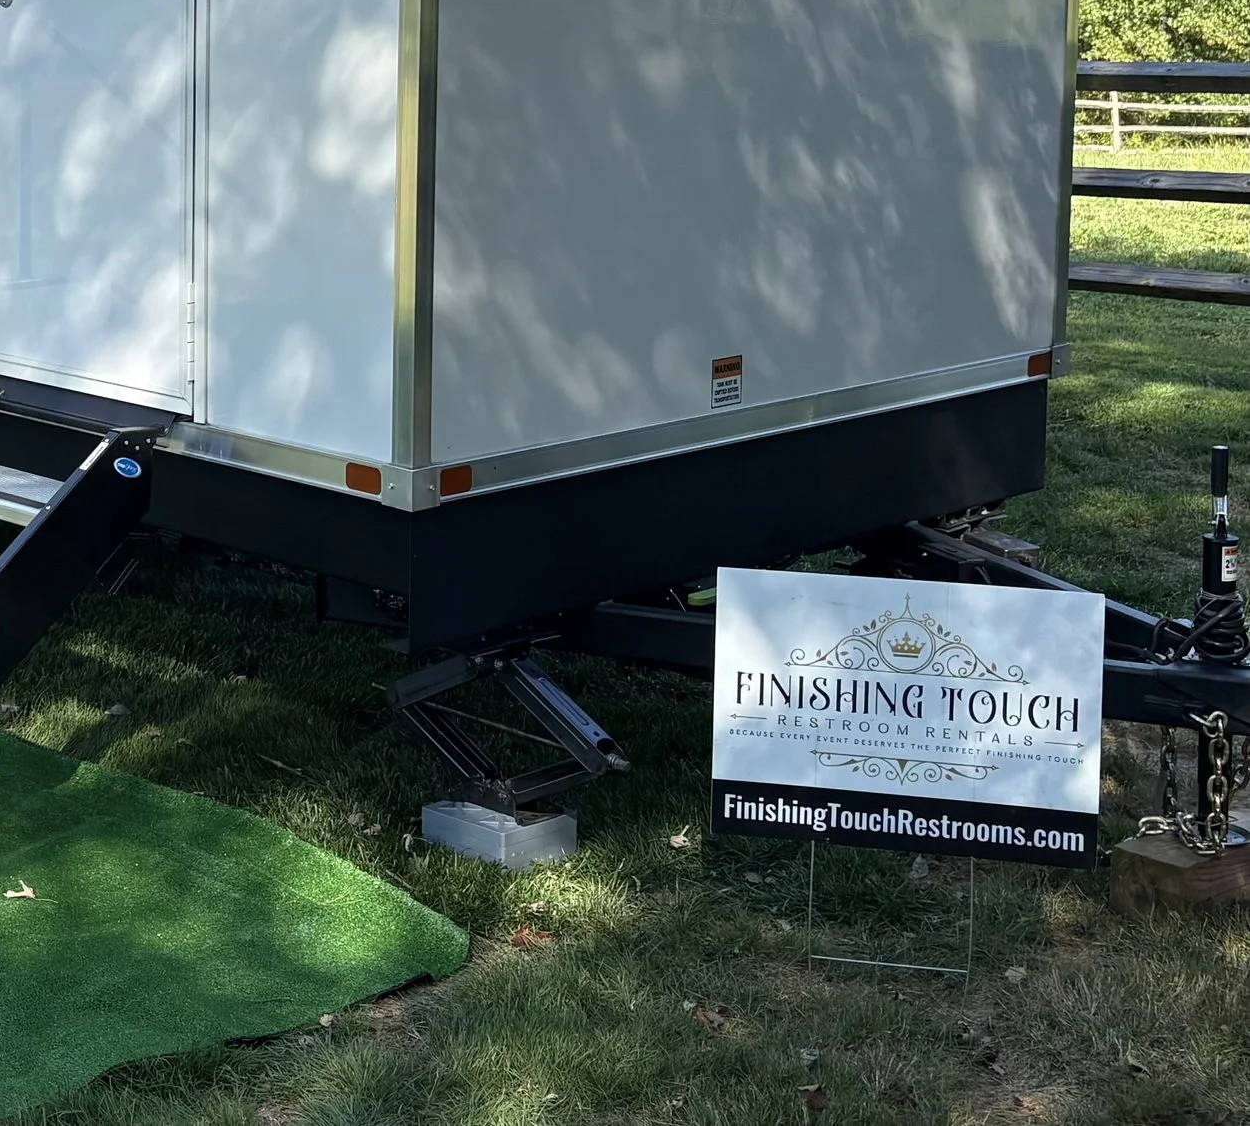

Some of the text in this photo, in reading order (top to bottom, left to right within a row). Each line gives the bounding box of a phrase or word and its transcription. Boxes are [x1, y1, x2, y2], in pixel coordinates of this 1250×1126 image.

[736, 671, 1079, 732] FINISHING TOUCH
[729, 728, 1084, 765] BECAUSE EVERY EVENT DESERVES THE PERFECT FINISHING TOUCH
[777, 714, 1033, 747] RESTROOM RENTALS
[723, 793, 1085, 852] FinishingTouchRestrooms.com
